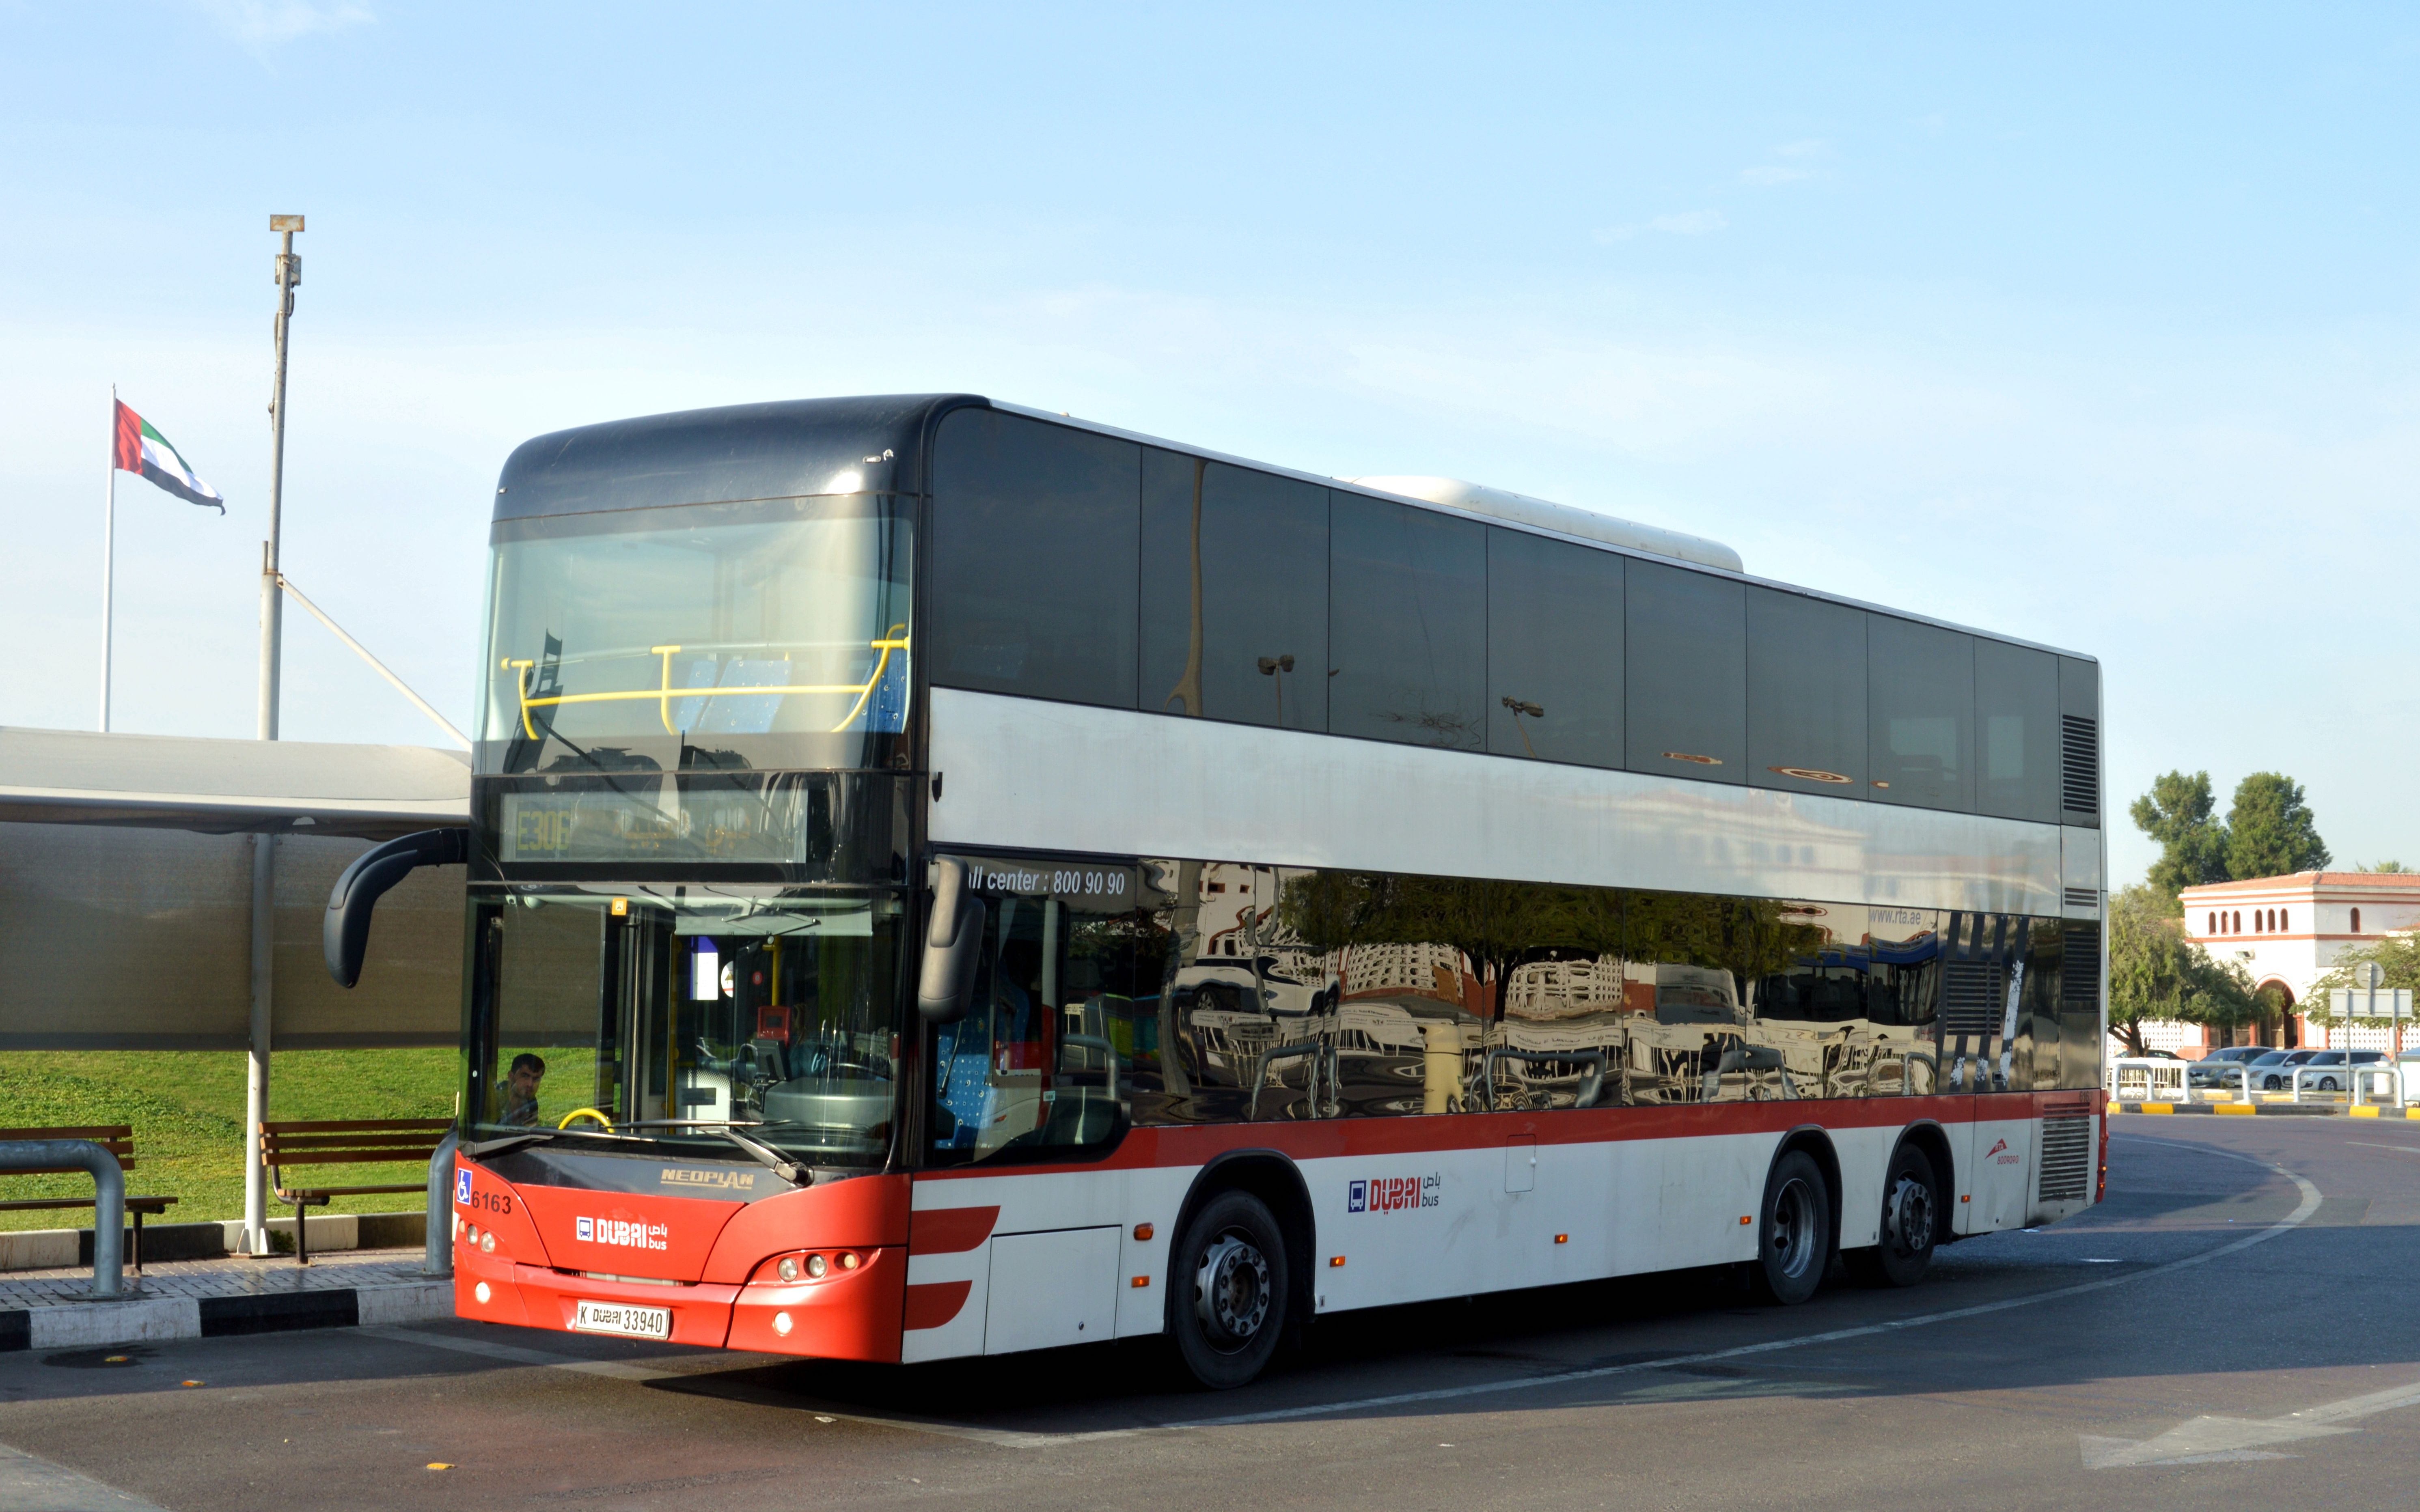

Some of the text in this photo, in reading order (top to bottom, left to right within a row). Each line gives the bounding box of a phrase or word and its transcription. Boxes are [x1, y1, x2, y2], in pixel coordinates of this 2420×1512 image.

[516, 810, 571, 851] E306
[987, 868, 1039, 892] center
[1053, 870, 1081, 894] 800
[1085, 871, 1103, 895] 90
[1107, 872, 1124, 895] 90
[1870, 909, 1921, 925] www.rta.ae
[1997, 1155, 2019, 1165] 8009090
[660, 1168, 754, 1190] NEOPLAN
[1423, 1172, 1441, 1189] باص
[471, 1190, 512, 1215] 6163
[1370, 1176, 1421, 1212] DUBAI
[1422, 1193, 1439, 1207] bus
[596, 1219, 647, 1249] DUBAI
[648, 1223, 668, 1238] باص
[648, 1237, 667, 1250] bus
[580, 1306, 663, 1333] K DUBAI 33940
